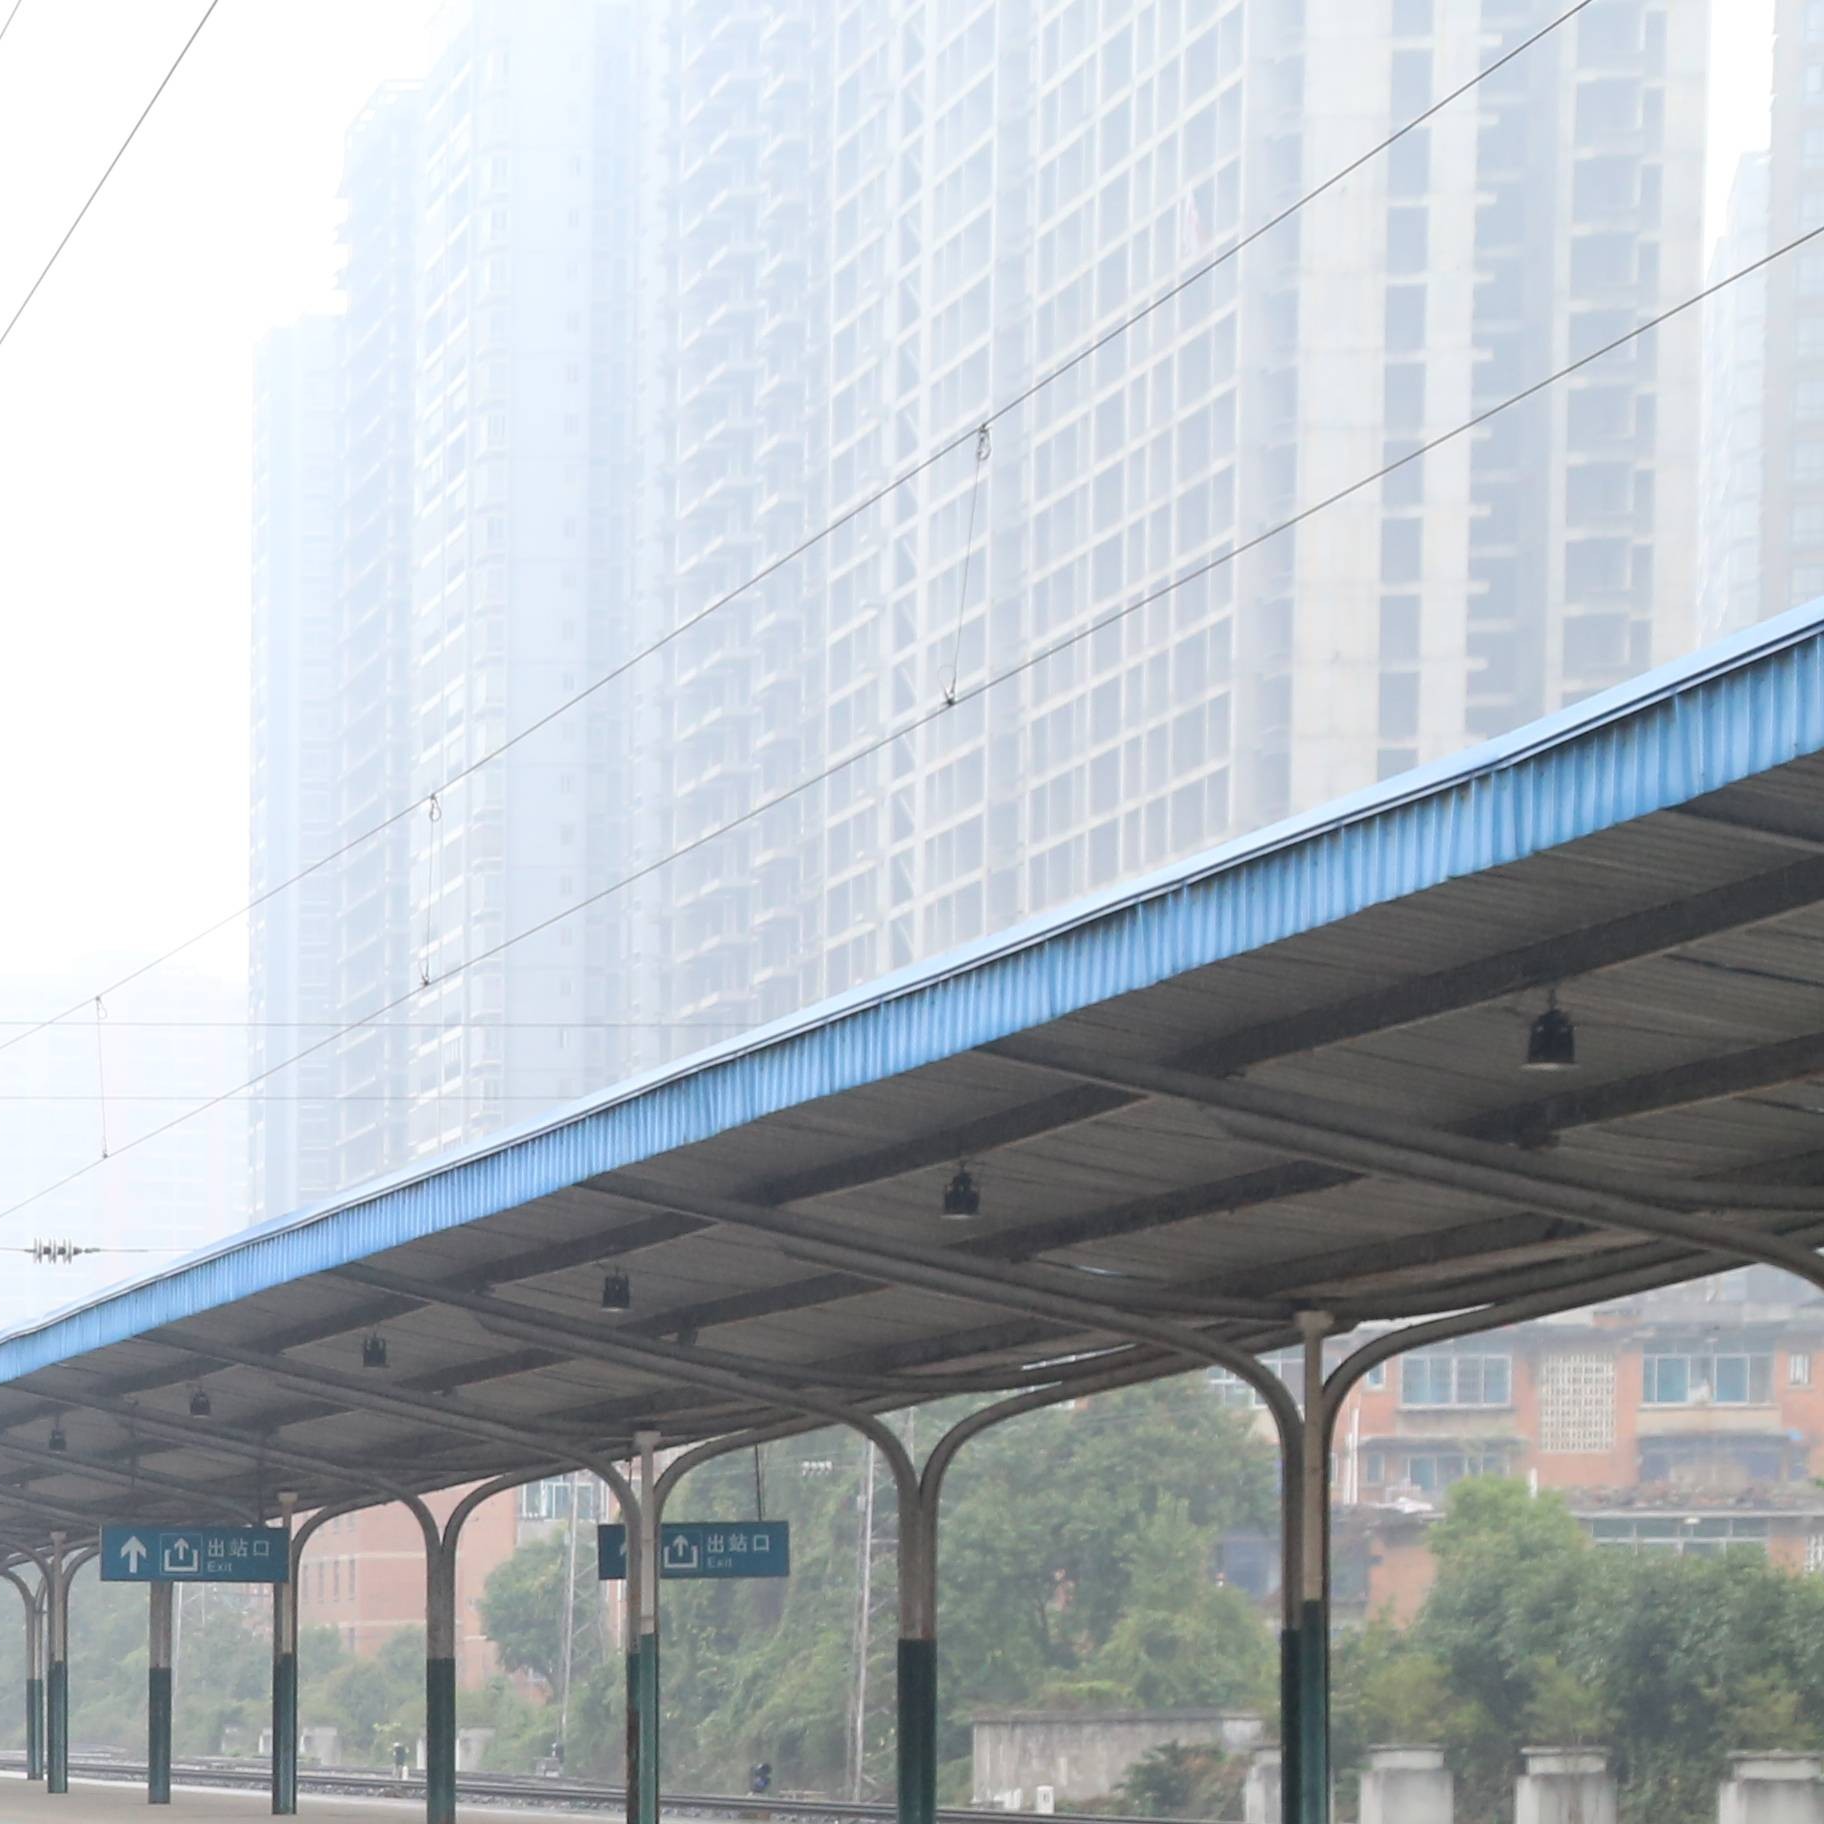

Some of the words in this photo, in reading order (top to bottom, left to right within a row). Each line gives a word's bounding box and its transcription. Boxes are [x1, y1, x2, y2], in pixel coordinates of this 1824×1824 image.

[207, 1538, 270, 1558] 出站口
[707, 1534, 770, 1553] 出站口
[207, 1561, 232, 1572] Exit
